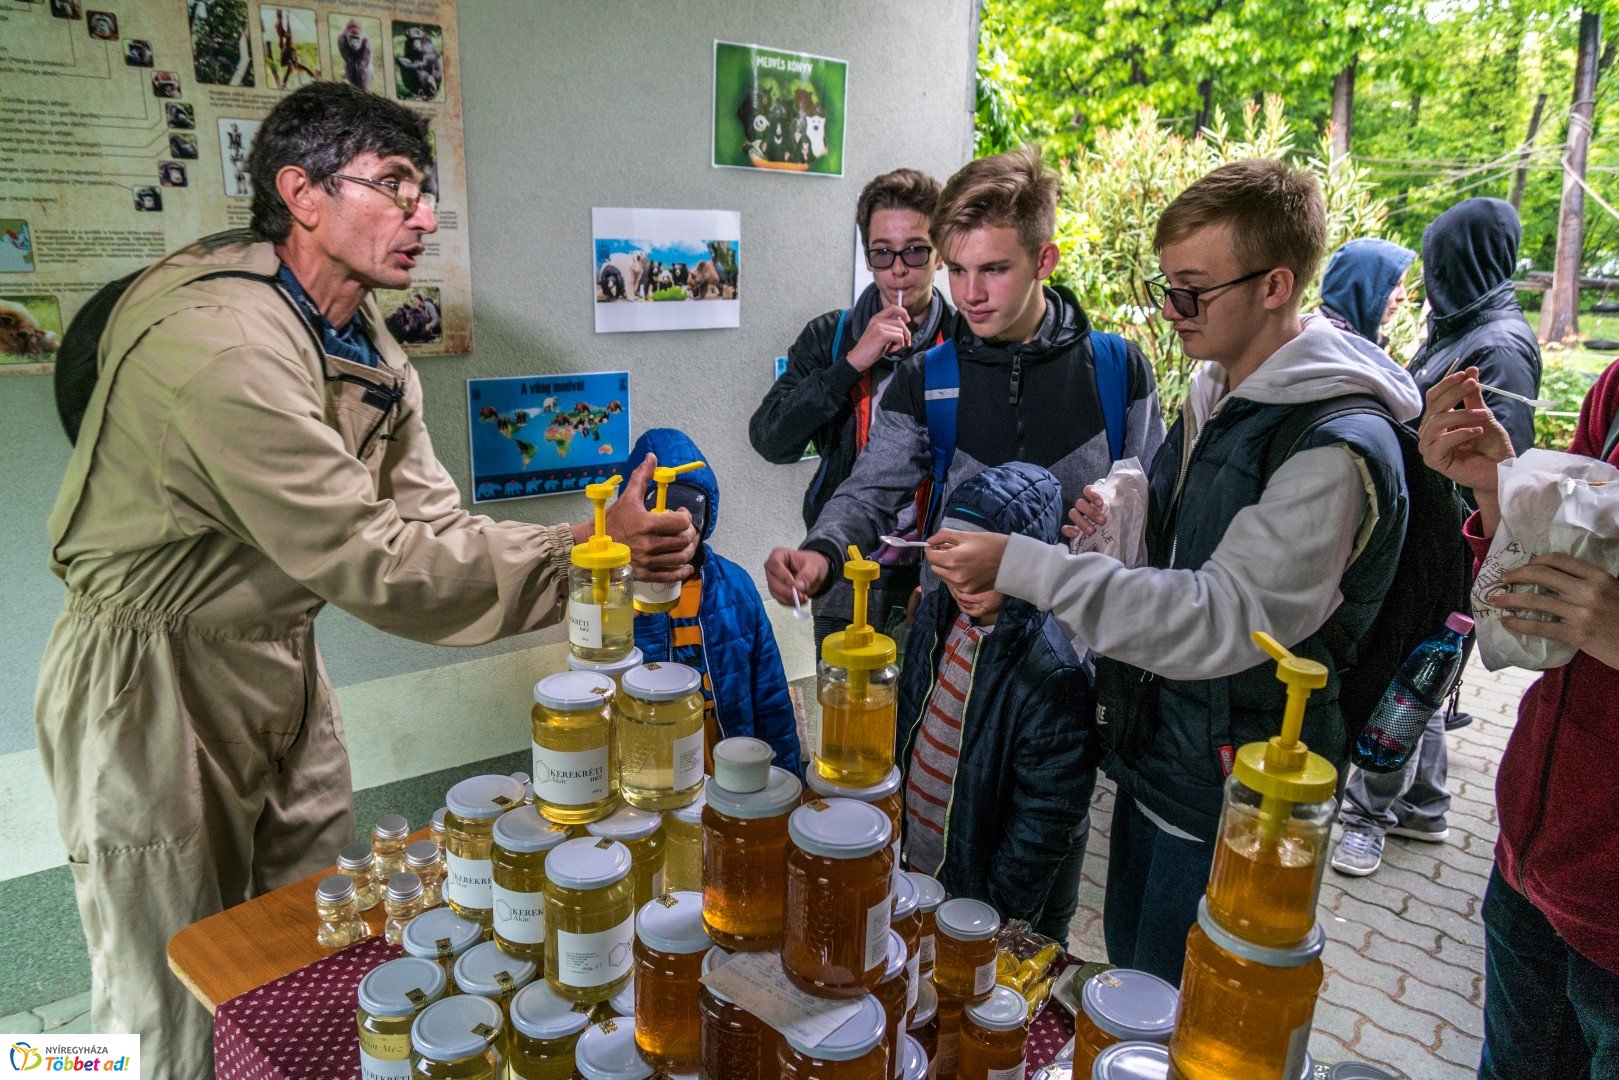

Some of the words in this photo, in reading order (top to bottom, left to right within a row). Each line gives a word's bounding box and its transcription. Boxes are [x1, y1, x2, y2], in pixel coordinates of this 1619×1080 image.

[757, 56, 786, 71] MEDVÉS
[521, 382, 528, 395] A
[529, 381, 552, 395] világ
[553, 379, 585, 393] medvéi
[550, 766, 603, 779] KEREKRÉTI
